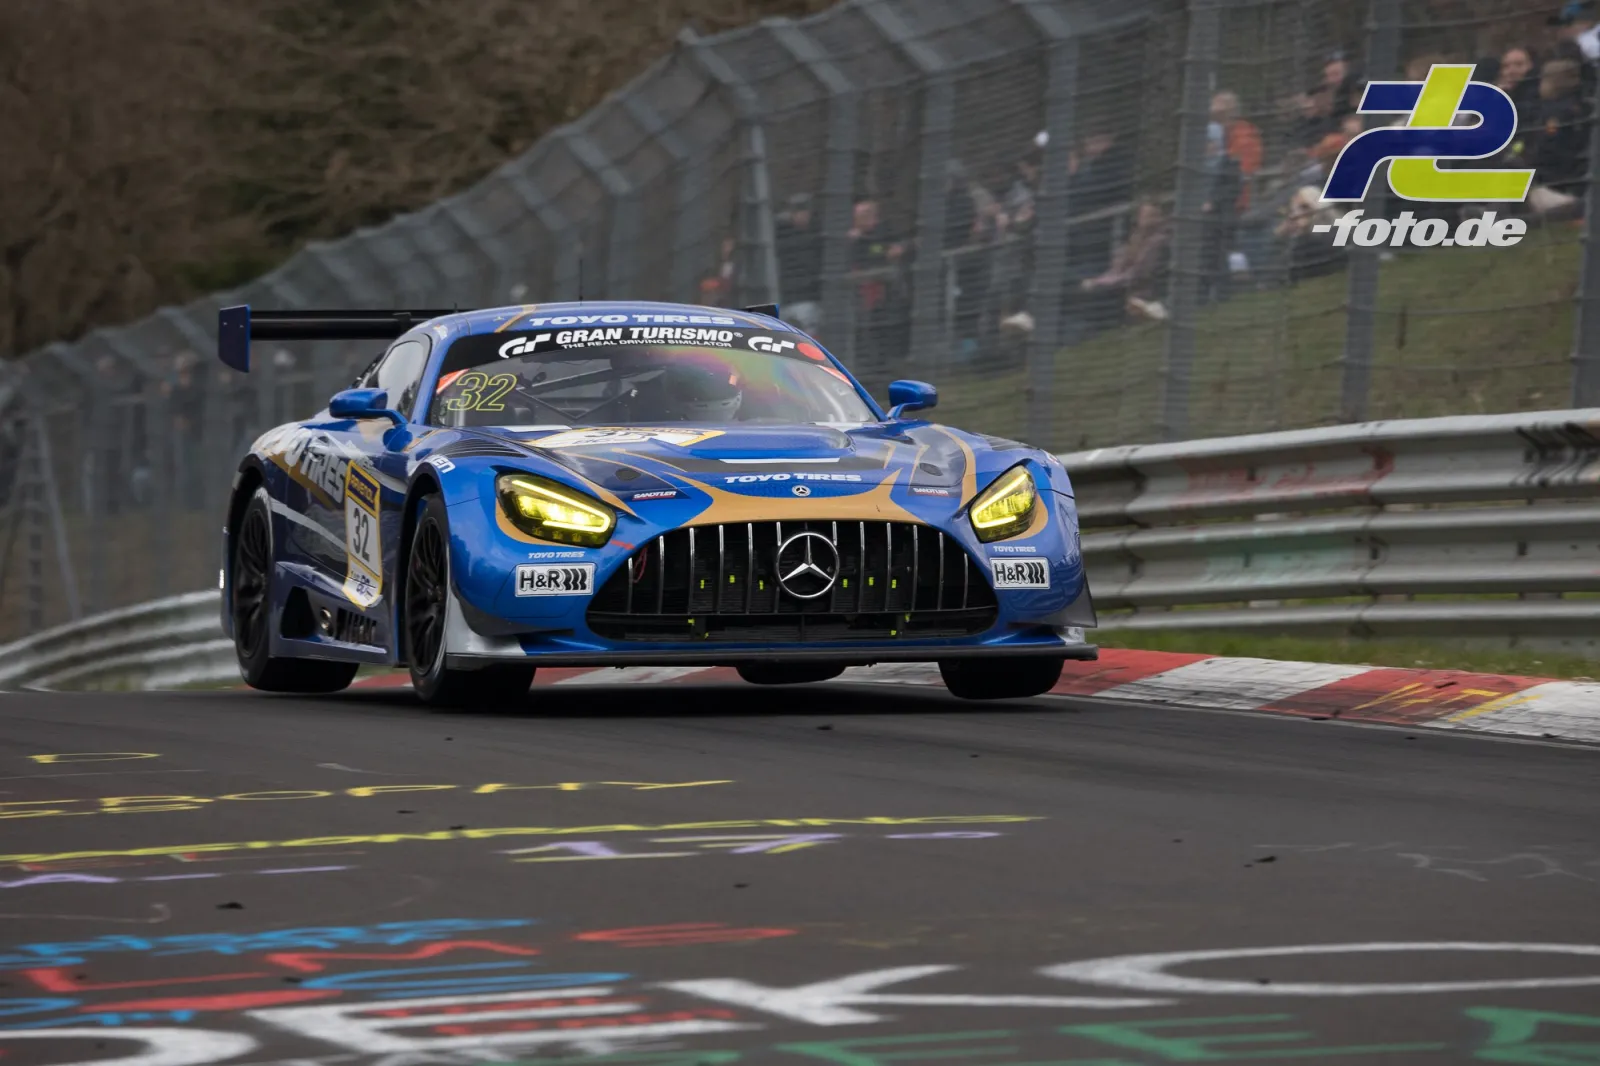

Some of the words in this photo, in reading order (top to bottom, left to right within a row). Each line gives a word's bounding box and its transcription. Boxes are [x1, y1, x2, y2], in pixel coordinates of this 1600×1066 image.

[529, 314, 629, 327] TOYO
[631, 313, 736, 326] TIRES
[556, 327, 624, 345] GRAN
[561, 342, 585, 350] THE
[587, 340, 617, 348] REAL
[619, 338, 666, 346] DRIVING
[667, 338, 733, 348] SIMULATOR
[447, 371, 518, 412] 32
[724, 473, 791, 484] TOYO
[793, 472, 862, 482] TIRES
[353, 507, 370, 563] 32
[993, 545, 1014, 553] TOYO
[520, 570, 561, 589] H&R
[994, 562, 1027, 582] H&R
